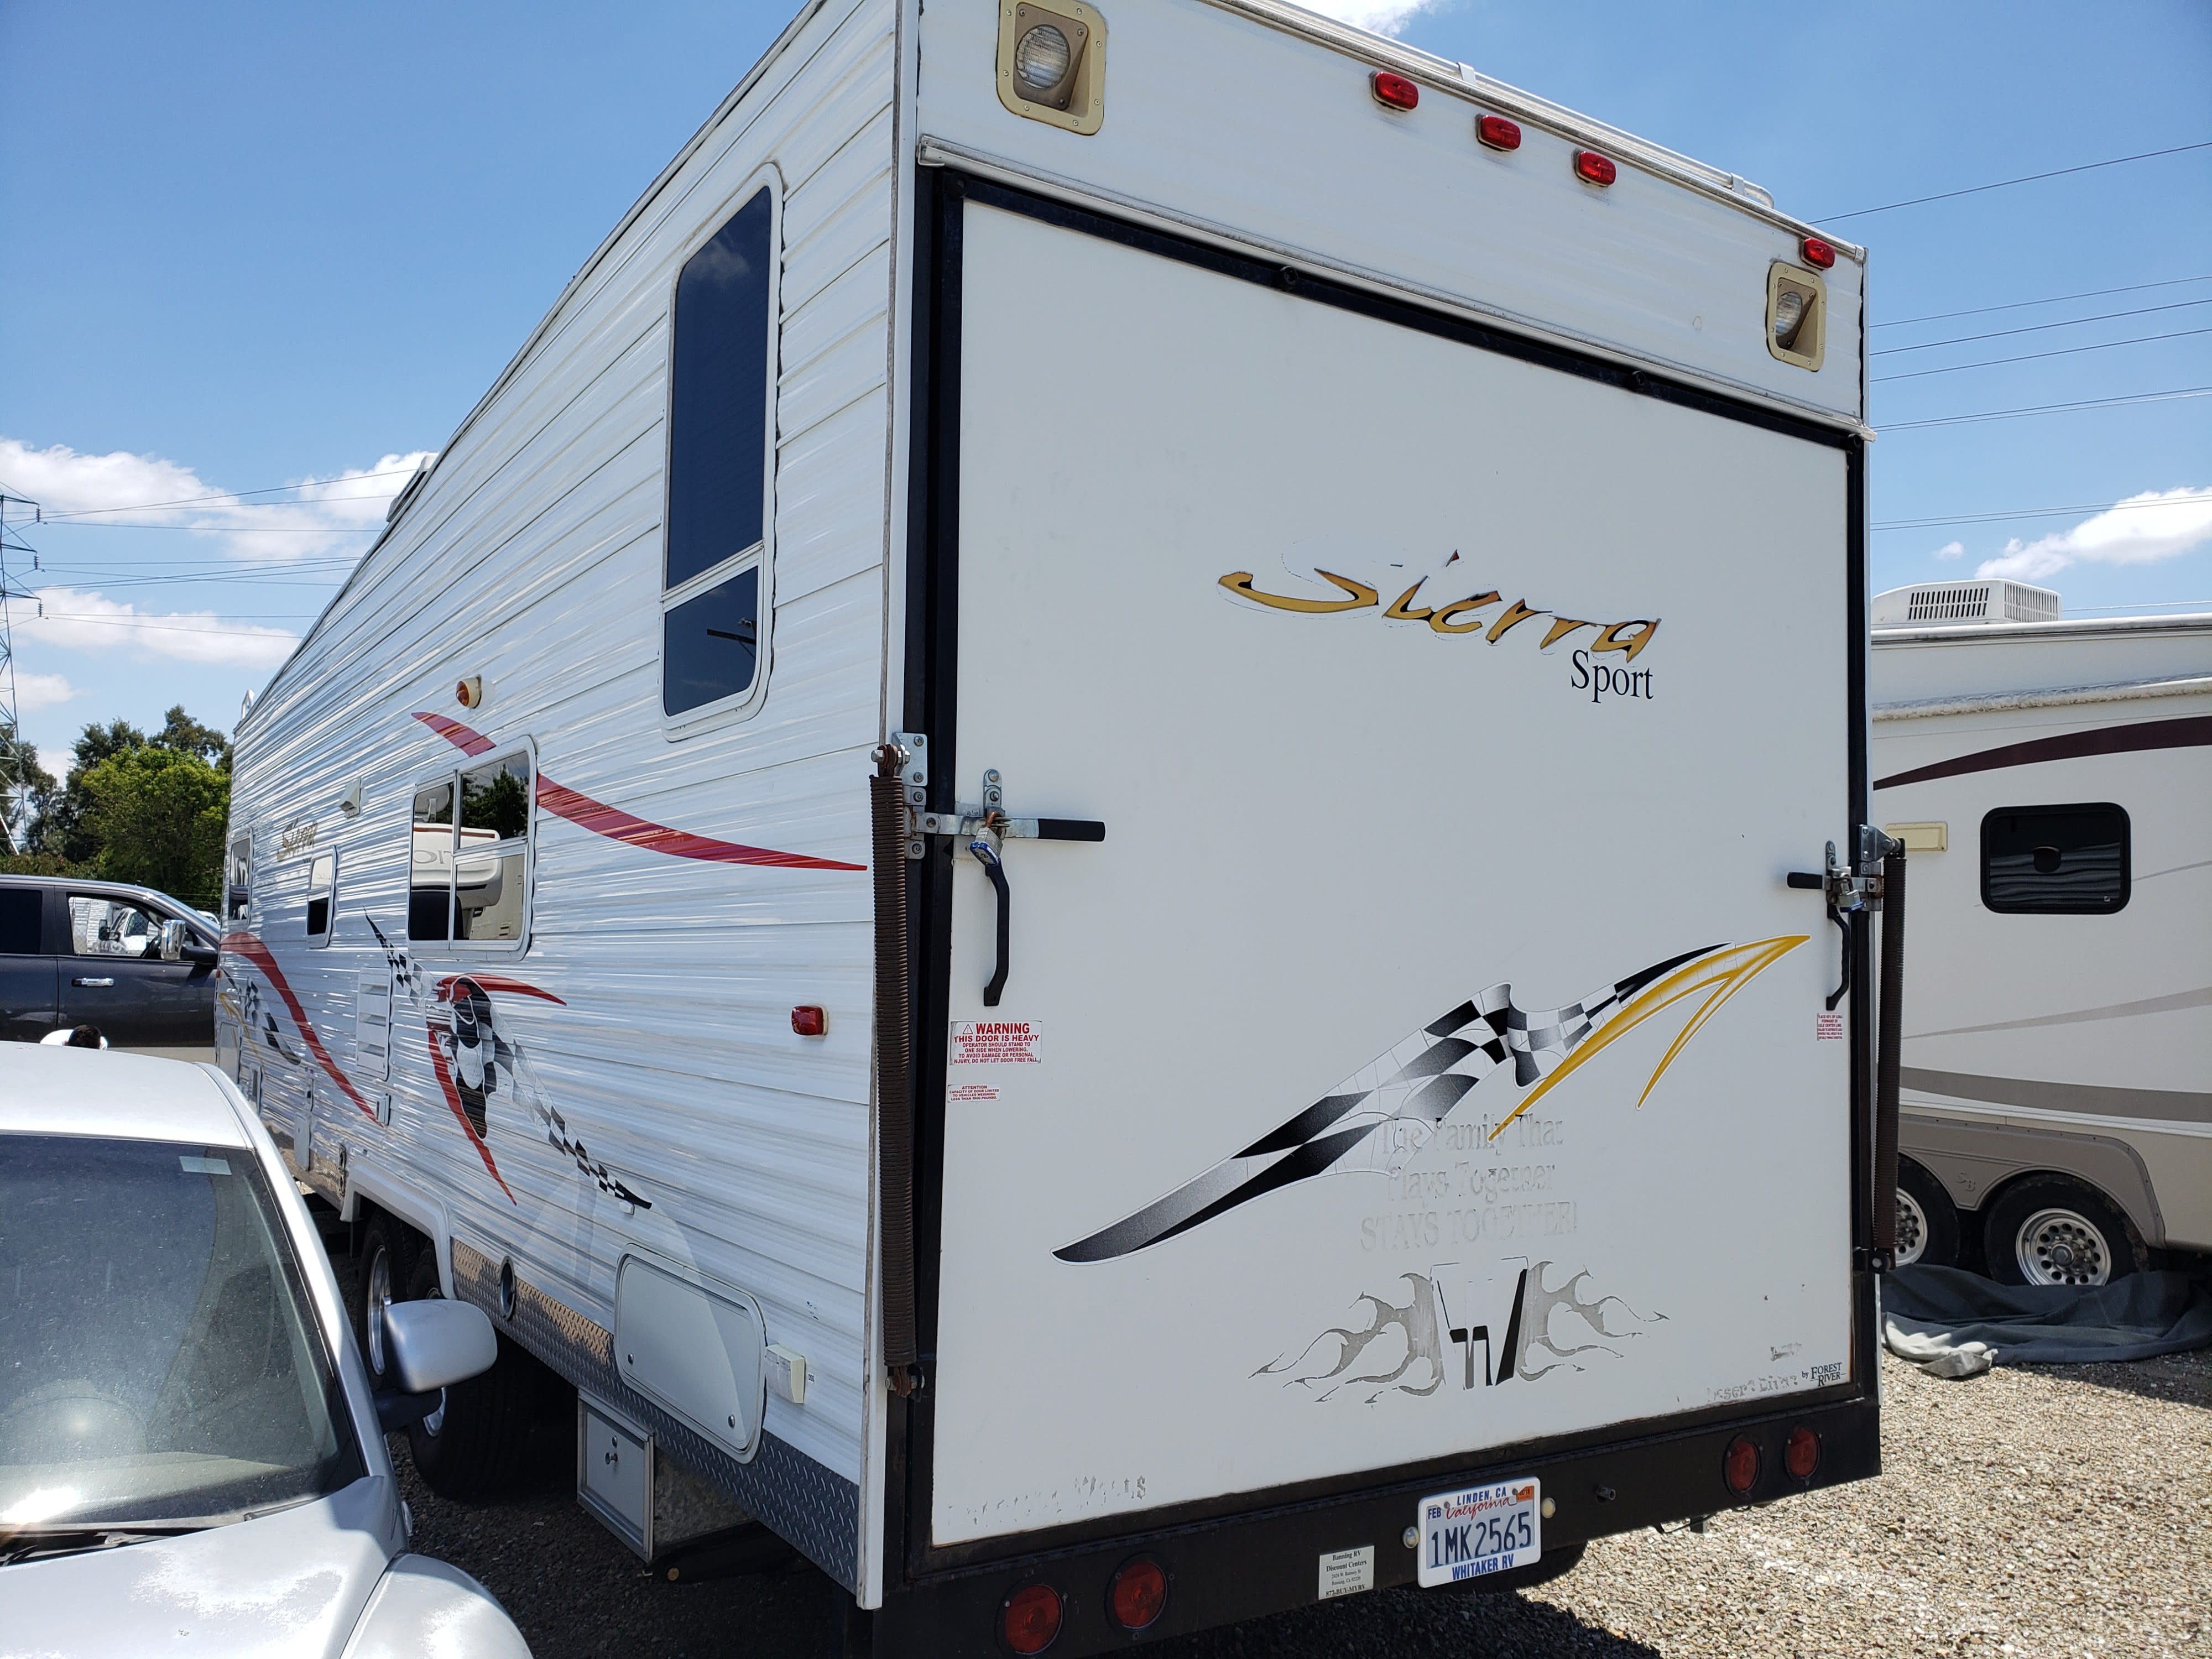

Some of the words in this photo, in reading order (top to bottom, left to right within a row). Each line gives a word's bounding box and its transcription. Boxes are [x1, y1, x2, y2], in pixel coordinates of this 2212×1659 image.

[1218, 549, 1661, 664] Sierra
[1571, 649, 1654, 703] Sport
[975, 1022, 1030, 1035] WARNING
[1360, 1211, 1438, 1253] STAYS
[1811, 1362, 1842, 1379] FOREST
[1818, 1371, 1840, 1387] RIVER
[1457, 1490, 1493, 1505] LINDEN,
[1495, 1486, 1506, 1498] CA
[1428, 1506, 1441, 1520] FEB
[1446, 1497, 1517, 1521] California
[1431, 1511, 1531, 1568] 1MK2565
[1326, 1563, 1347, 1572] Discount
[1452, 1557, 1499, 1580] WHITAKER
[1502, 1553, 1514, 1569] RV
[1326, 1584, 1366, 1597] 877-BUY-MYRV
